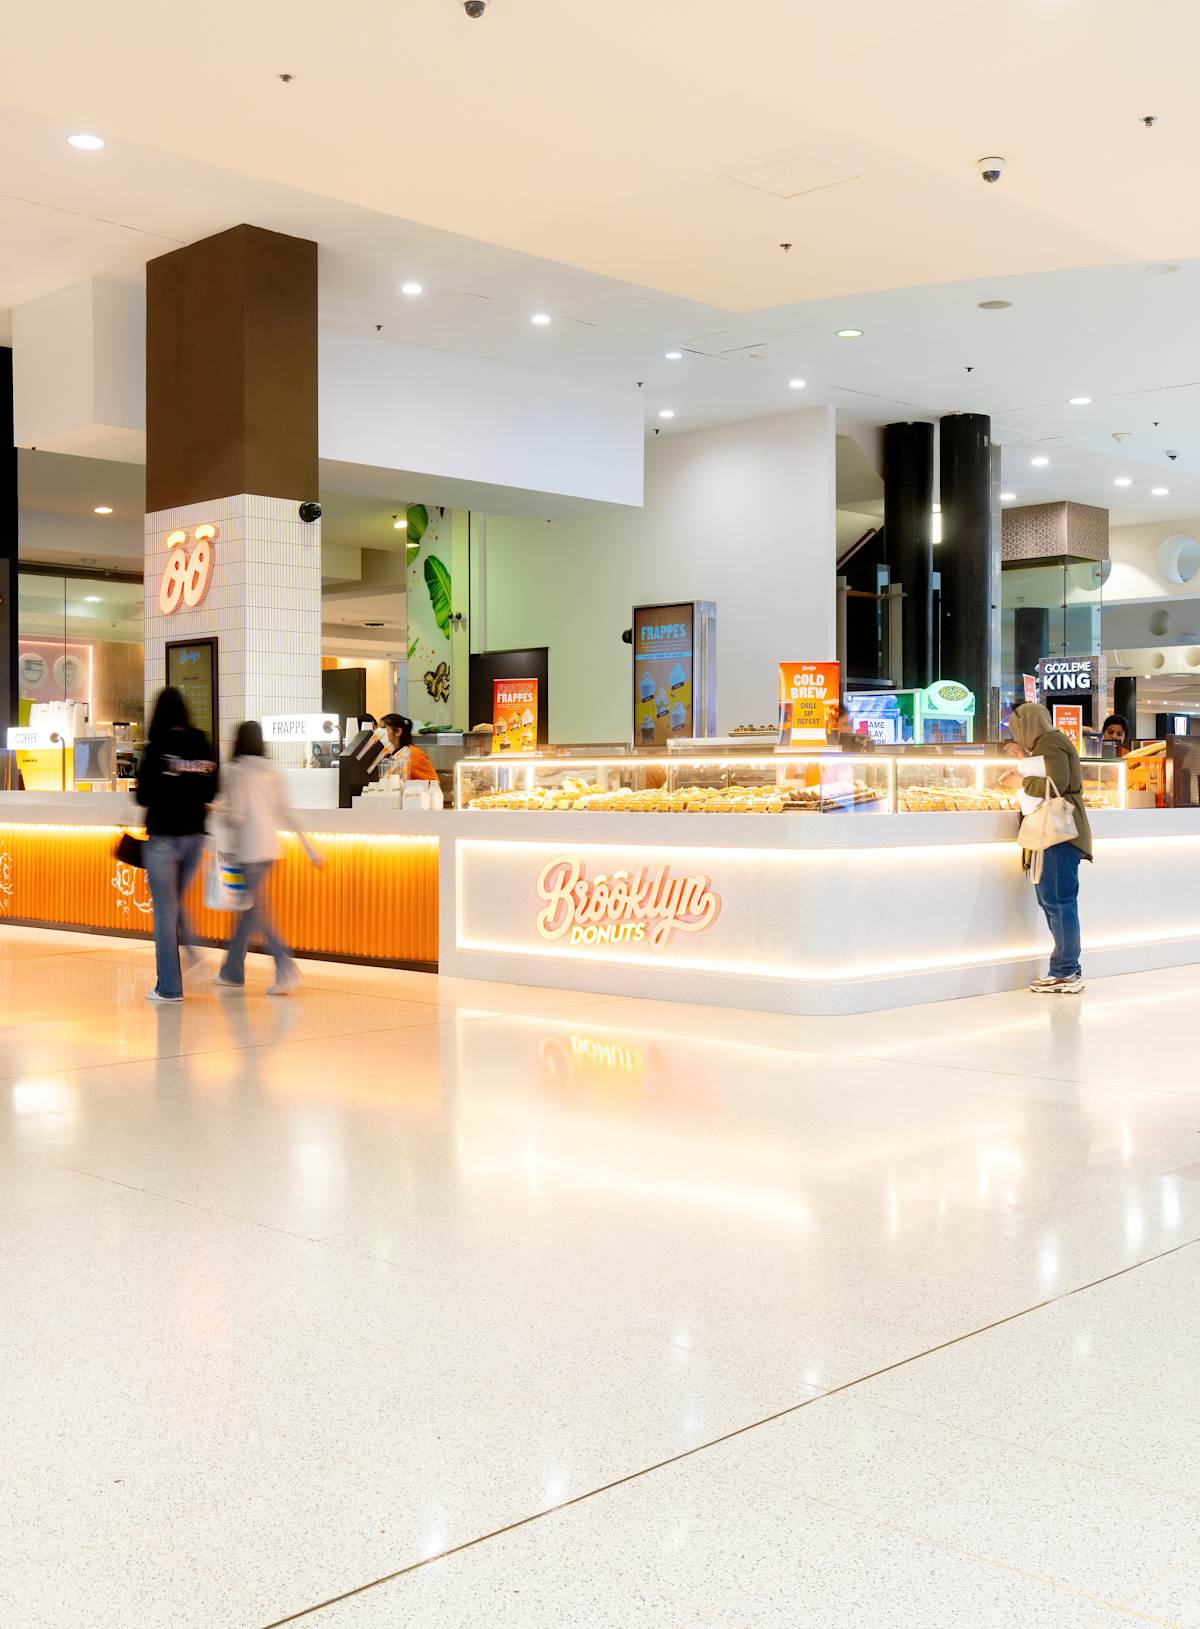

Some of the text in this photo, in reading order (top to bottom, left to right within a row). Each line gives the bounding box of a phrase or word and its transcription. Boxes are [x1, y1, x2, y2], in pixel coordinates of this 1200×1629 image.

[641, 623, 686, 640] FRAPPES
[1044, 662, 1092, 673] GOZLEME
[793, 673, 825, 687] COLD
[1043, 673, 1091, 690] KING
[496, 692, 534, 703] FRAPPES
[790, 686, 828, 700] BREW
[272, 720, 307, 735] FRAPPE
[867, 721, 885, 729] AME
[15, 732, 38, 744] COFFEE
[569, 922, 648, 945] DONUTS
